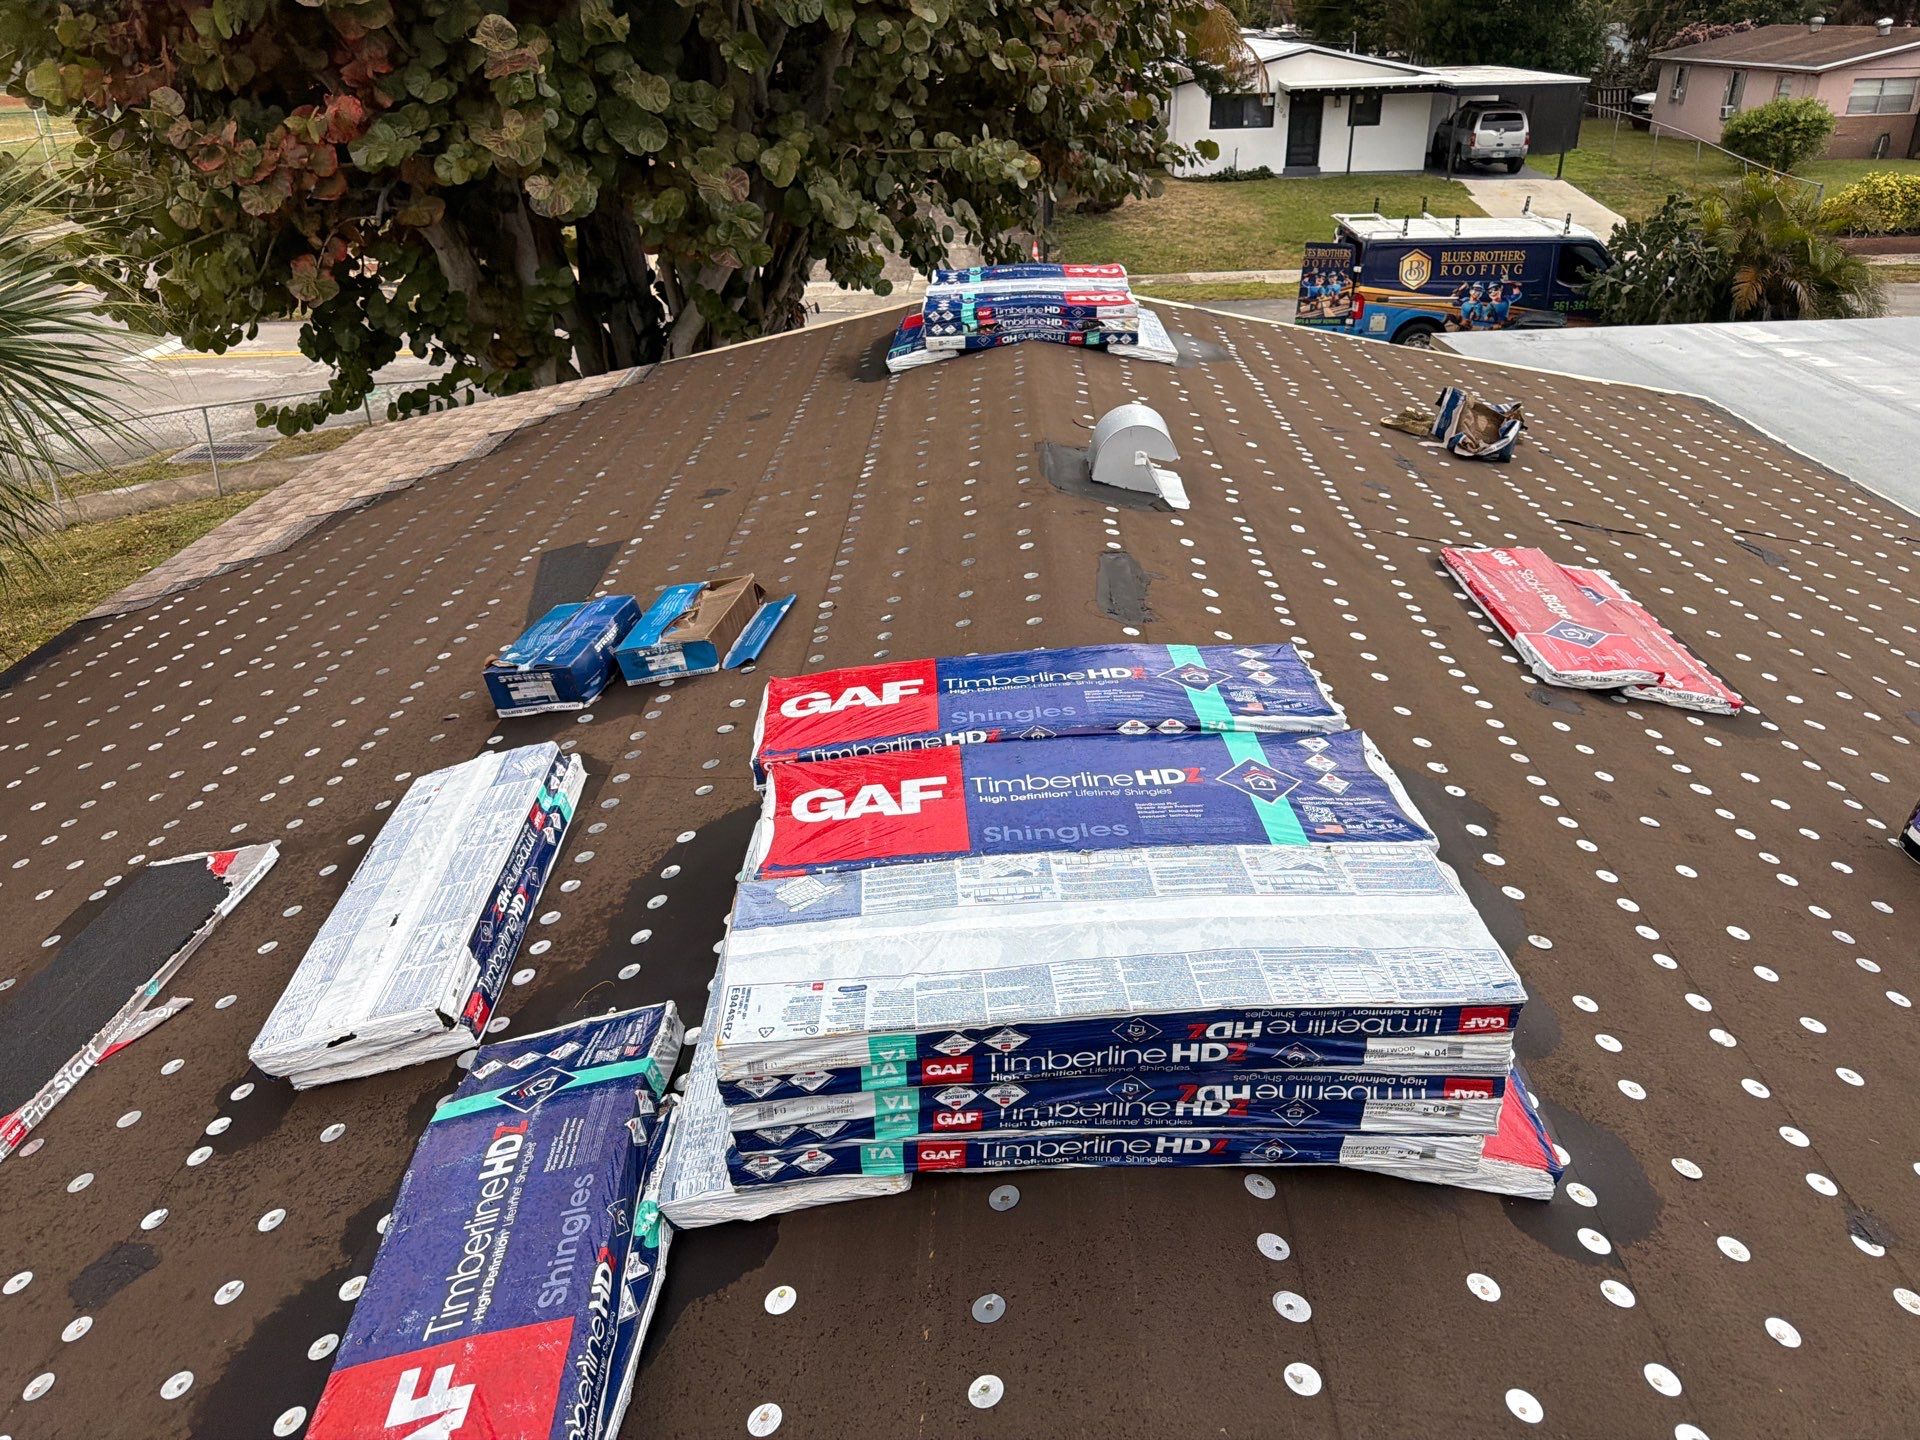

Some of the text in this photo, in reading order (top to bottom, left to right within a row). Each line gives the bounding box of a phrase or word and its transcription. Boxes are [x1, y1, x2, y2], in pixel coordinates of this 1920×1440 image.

[1317, 248, 1352, 258] BROTHERS
[1441, 250, 1526, 262] BLUES BROTHERS
[1303, 259, 1350, 267] OOFING
[1440, 264, 1523, 276] ROOFING
[1491, 550, 1520, 567] GAF
[780, 678, 924, 718] GAF
[951, 705, 1076, 725] Shingles
[790, 776, 947, 823] GAF
[979, 795, 1008, 804] High
[1011, 790, 1068, 802] Definition
[1124, 787, 1173, 798] Shingles
[983, 822, 1130, 843] Shingles
[721, 987, 741, 1041] E944SRZ
[1245, 1010, 1295, 1018] Shingles
[1414, 1009, 1443, 1017] High
[1463, 1017, 1506, 1029] GAF
[1434, 1048, 1447, 1057] 04
[871, 1064, 899, 1077] TA
[925, 1063, 970, 1077] GAF
[991, 1073, 1020, 1082] High
[1139, 1064, 1190, 1073] Shingles
[1233, 1073, 1282, 1082] Shingles
[1340, 1075, 1396, 1084] Definition
[1400, 1077, 1428, 1085] High
[882, 1096, 912, 1110] TA
[1433, 1105, 1446, 1113] 04
[936, 1113, 980, 1125] GAF
[1144, 1117, 1193, 1126] Shingles
[6, 1124, 21, 1142] GAF
[868, 1147, 896, 1160] TA
[921, 1149, 963, 1161] GAF
[983, 1159, 1011, 1167] High
[1126, 1154, 1173, 1164] Shingles
[472, 1291, 491, 1324] High
[483, 1231, 510, 1290] Definition
[515, 1141, 537, 1183] Shingles
[538, 1173, 595, 1308] Shingles
